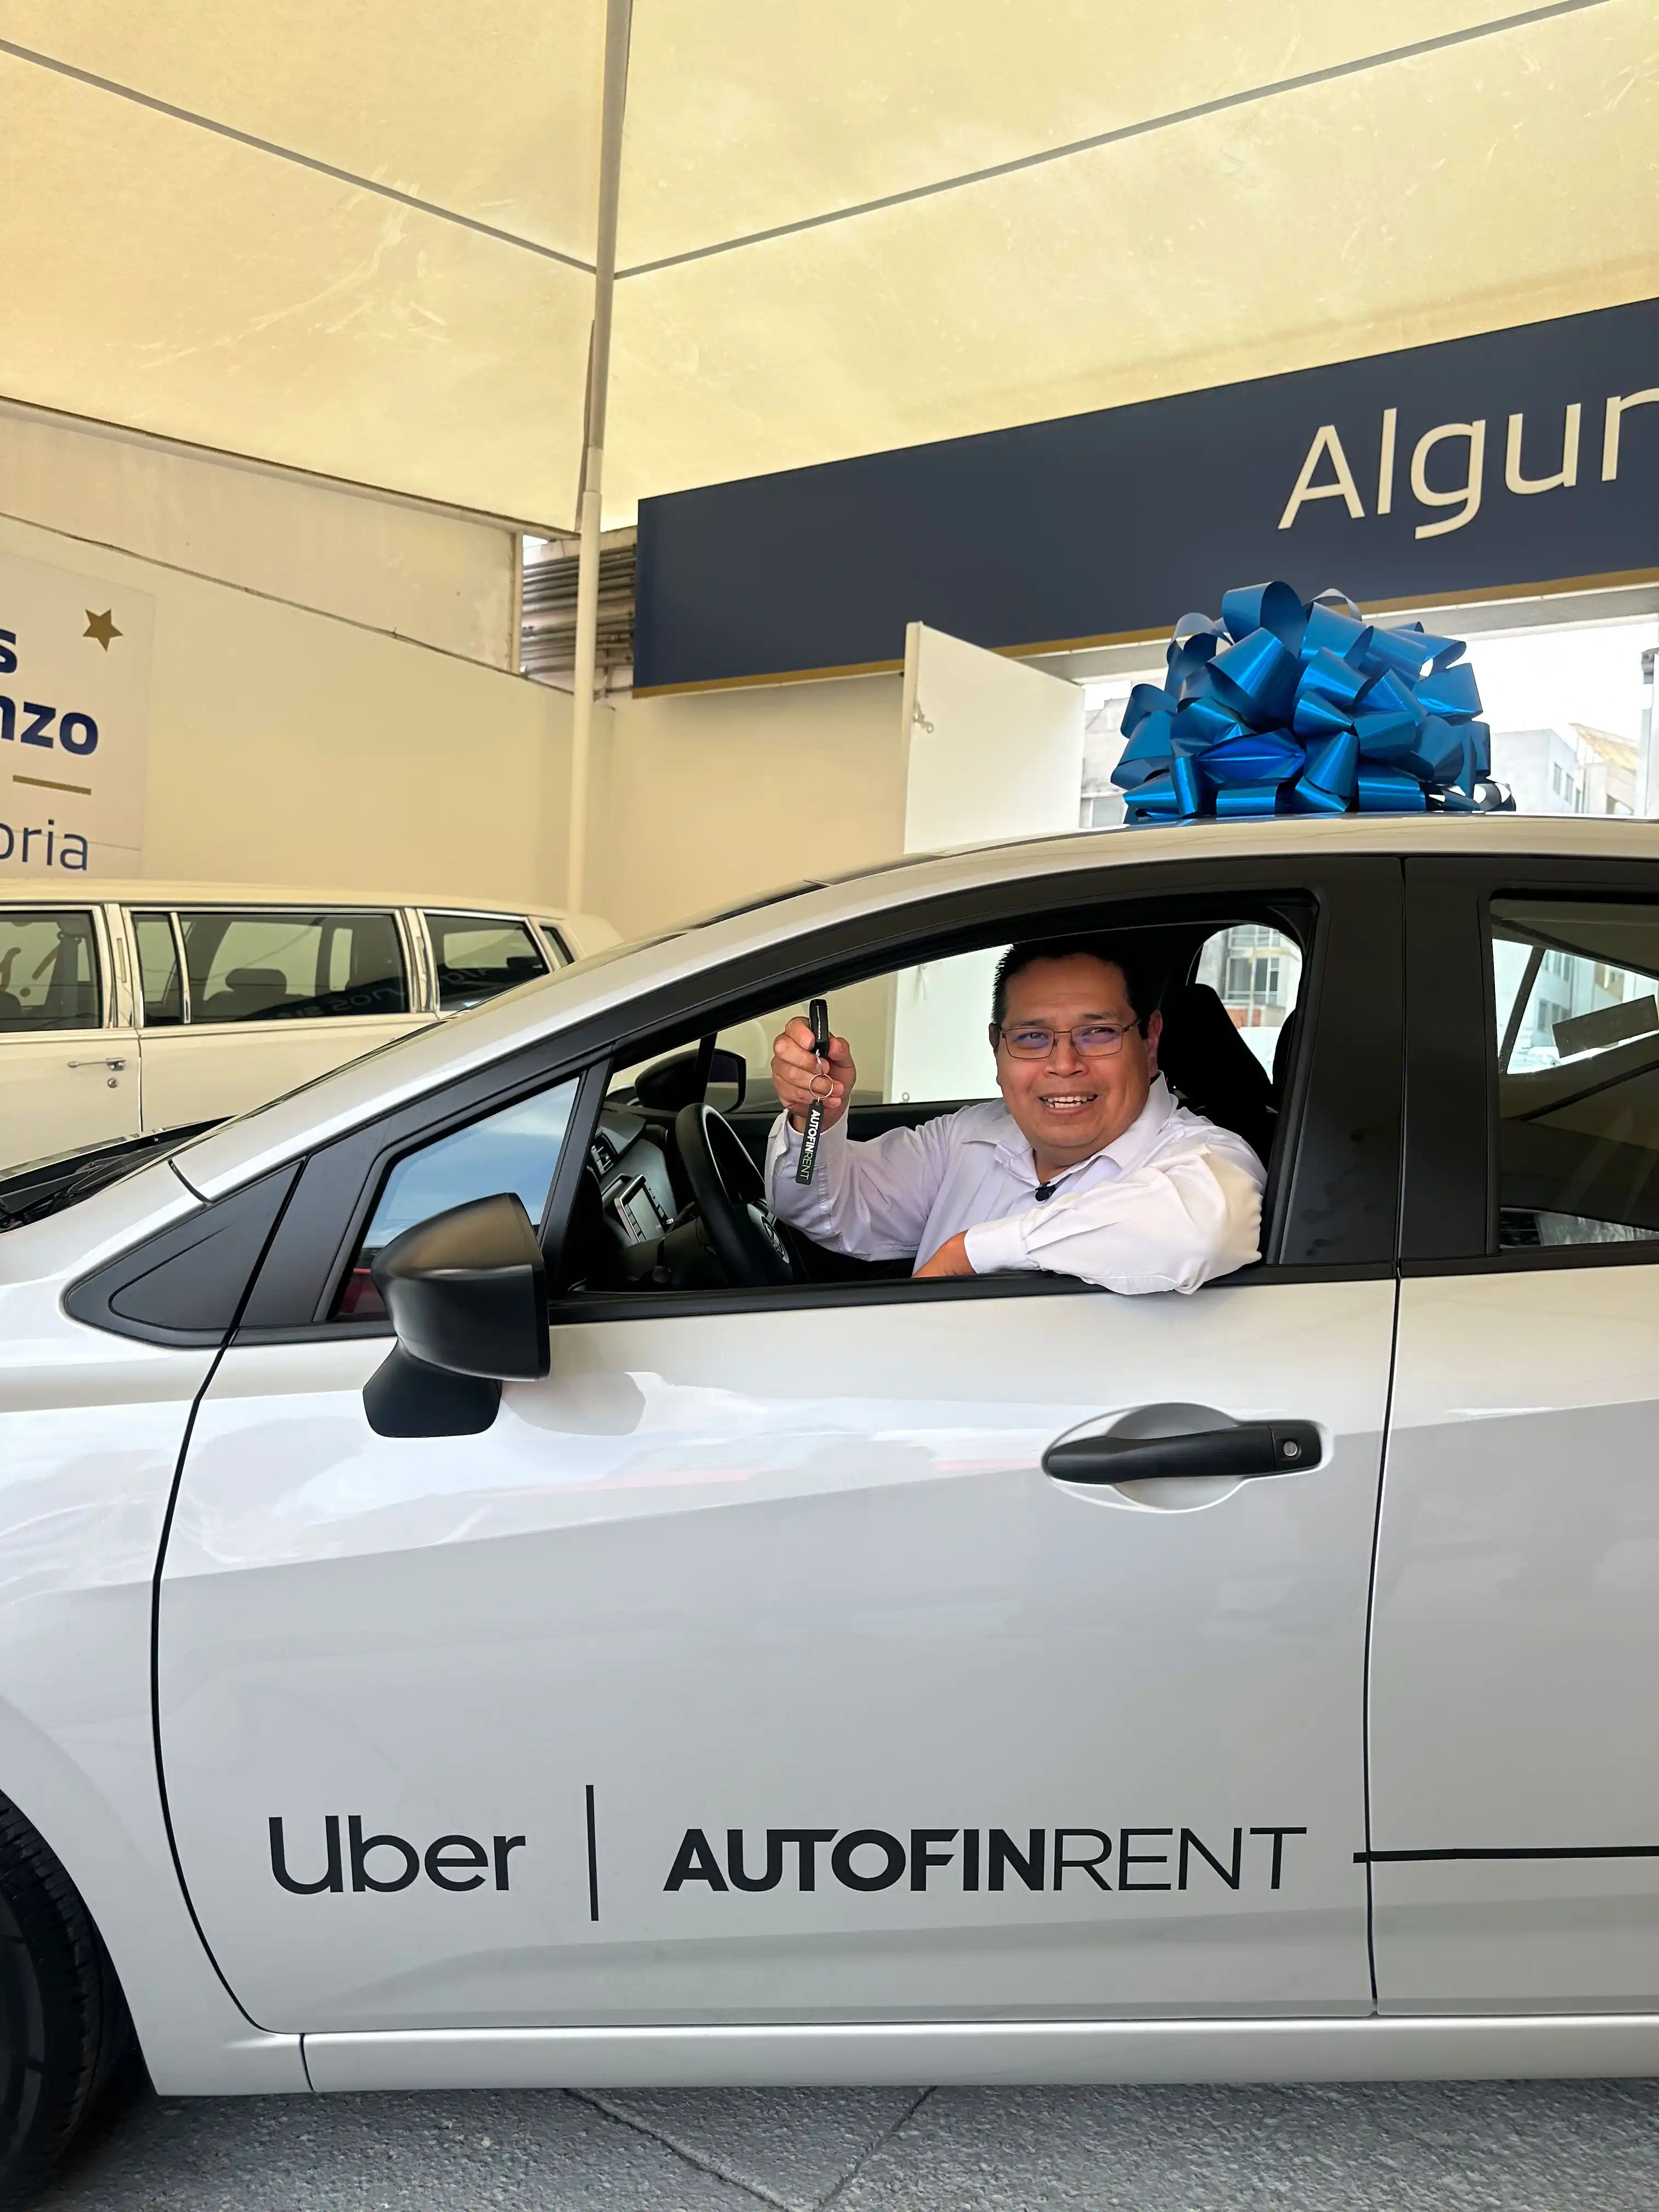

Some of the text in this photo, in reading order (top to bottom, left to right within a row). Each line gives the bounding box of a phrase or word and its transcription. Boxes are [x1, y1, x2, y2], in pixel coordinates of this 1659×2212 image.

[800, 1109, 821, 1181] AUTOFINRENT
[268, 1815, 1307, 1895] Uber AUTOFINRENT
